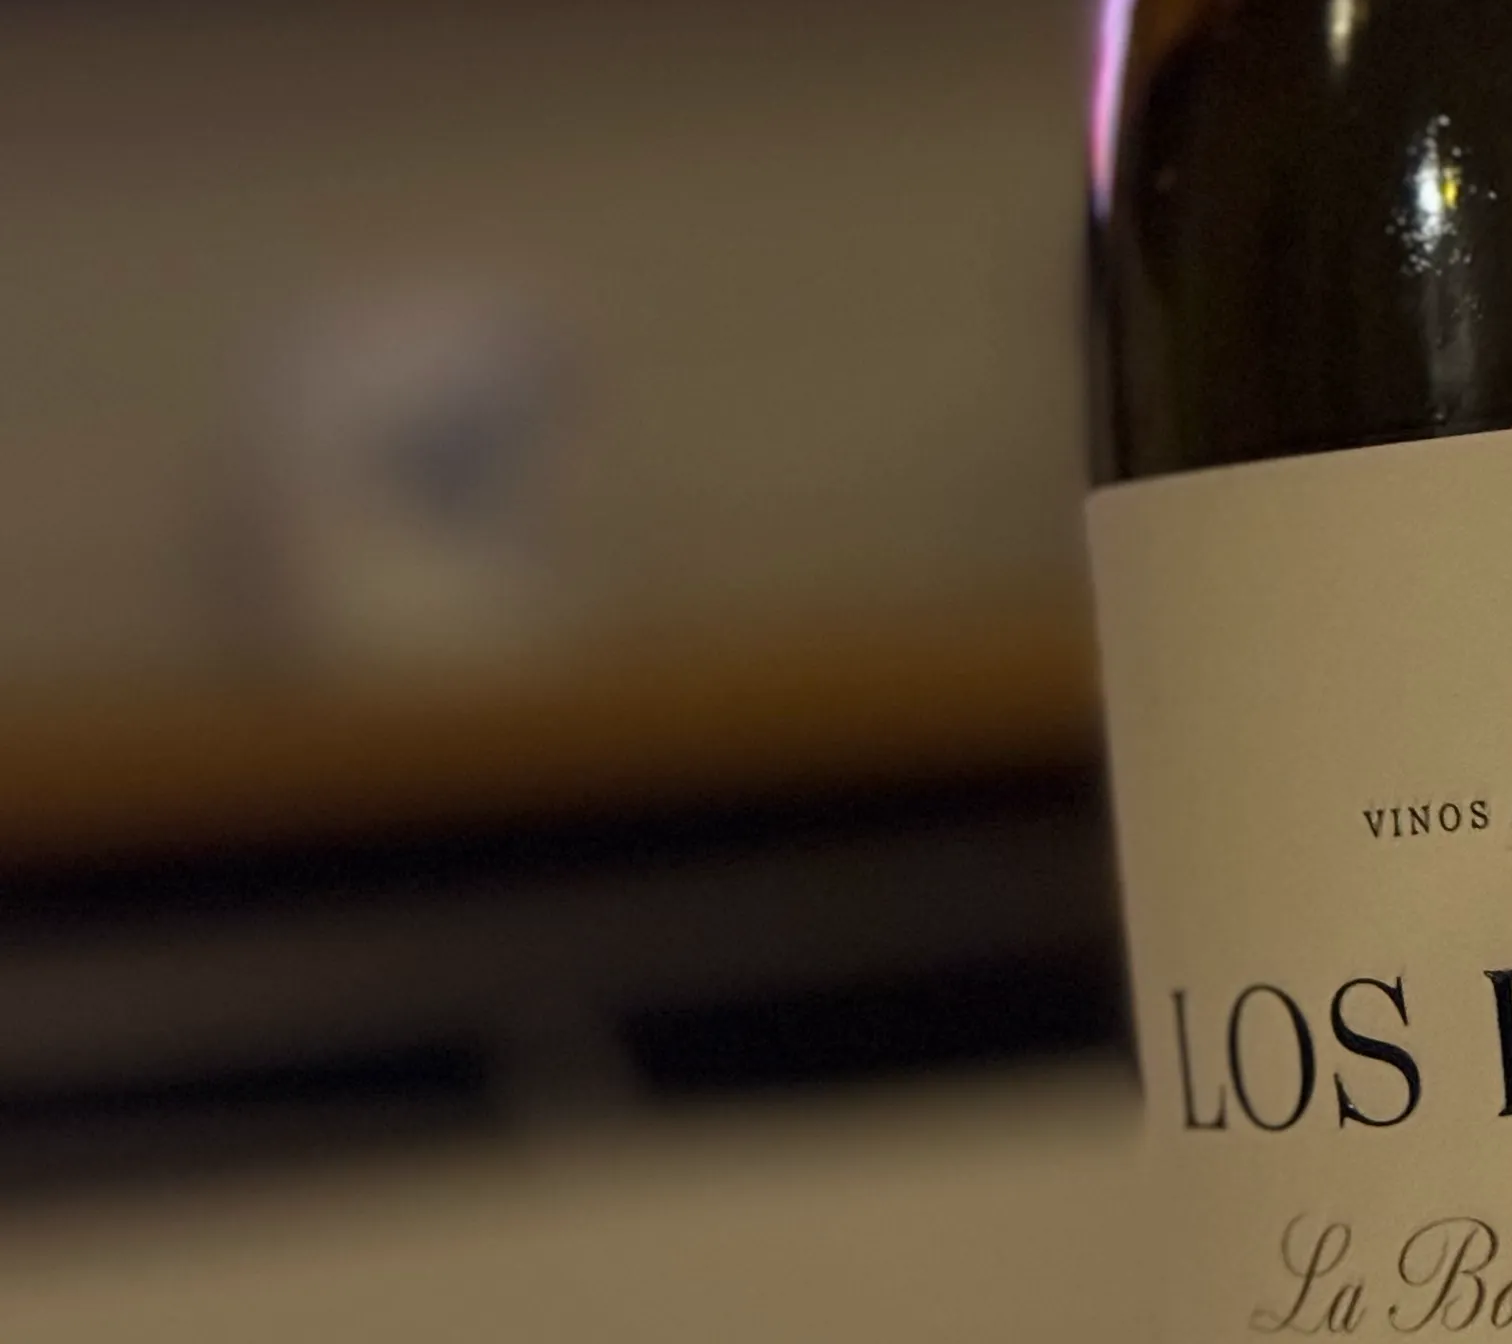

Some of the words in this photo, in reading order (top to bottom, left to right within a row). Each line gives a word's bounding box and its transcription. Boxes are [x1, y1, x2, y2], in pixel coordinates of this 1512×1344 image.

[1363, 798, 1491, 840] VINOS
[1170, 975, 1422, 1133] LOS
[1248, 1209, 1367, 1335] La
